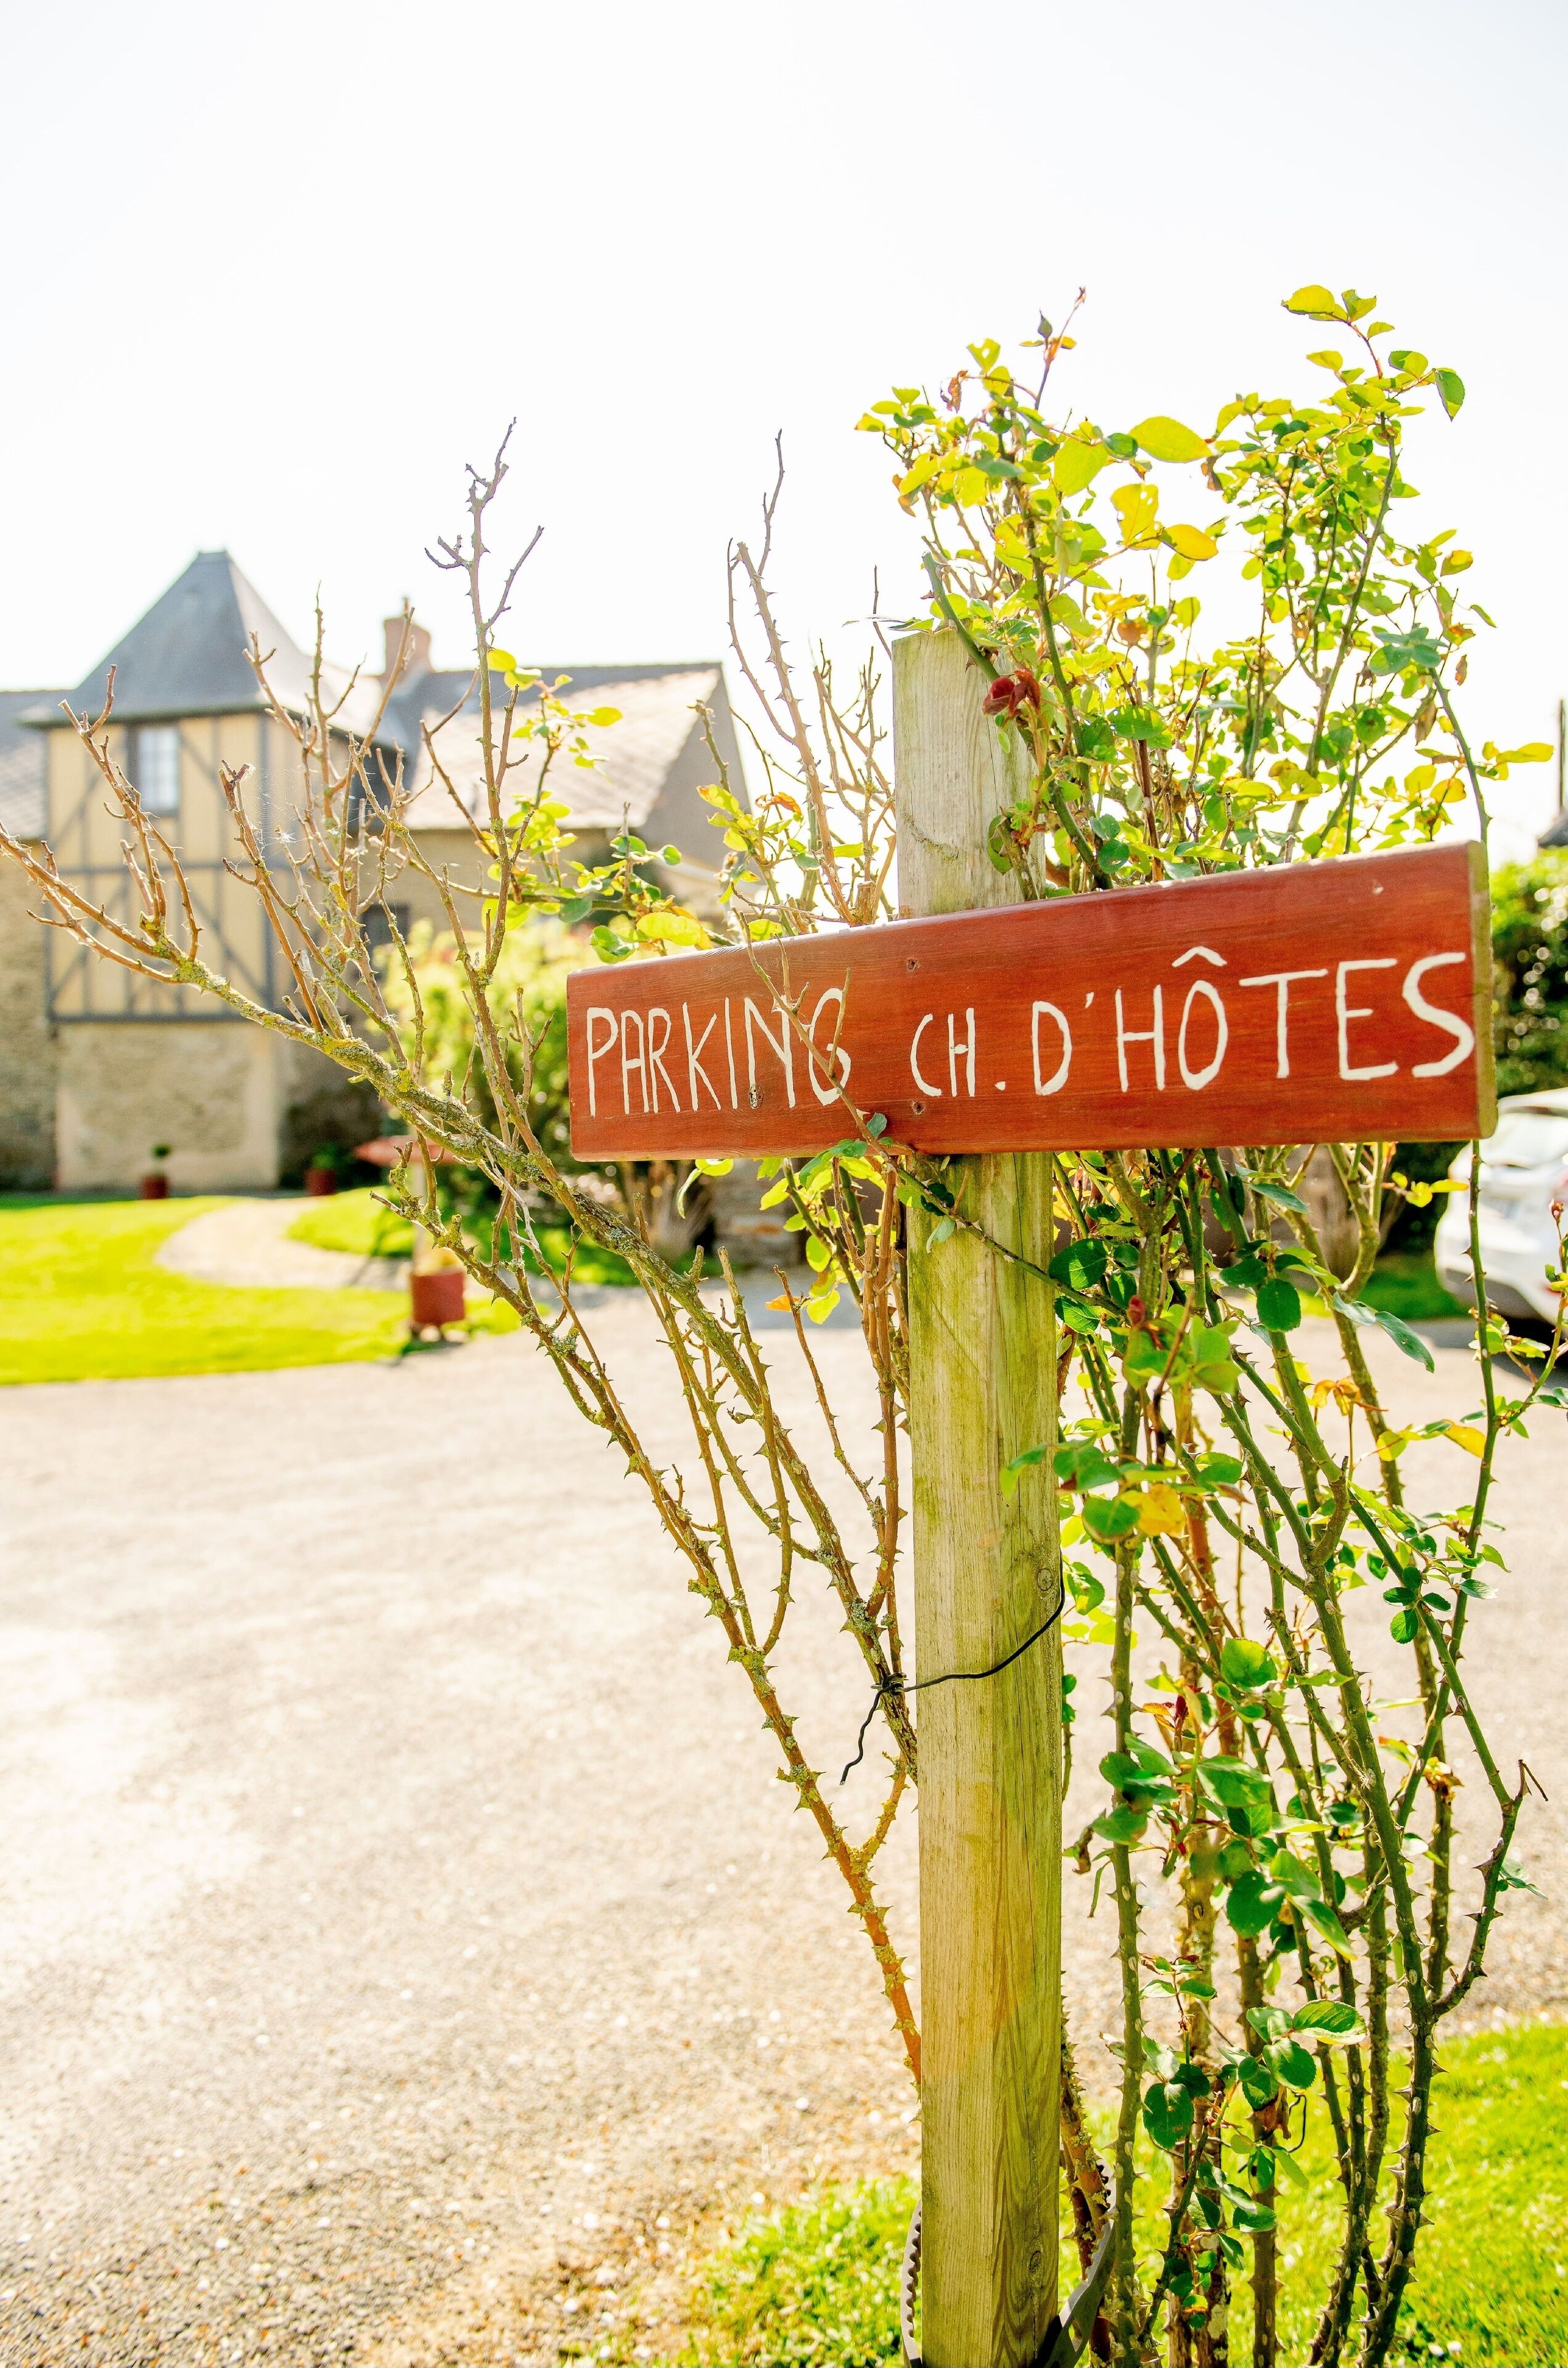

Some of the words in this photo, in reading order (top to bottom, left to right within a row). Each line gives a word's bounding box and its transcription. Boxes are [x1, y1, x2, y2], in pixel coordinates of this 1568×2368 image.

[586, 987, 852, 1117] PARKING
[910, 1007, 1006, 1097] CH.
[1032, 946, 1474, 1096] D'HÔTES
